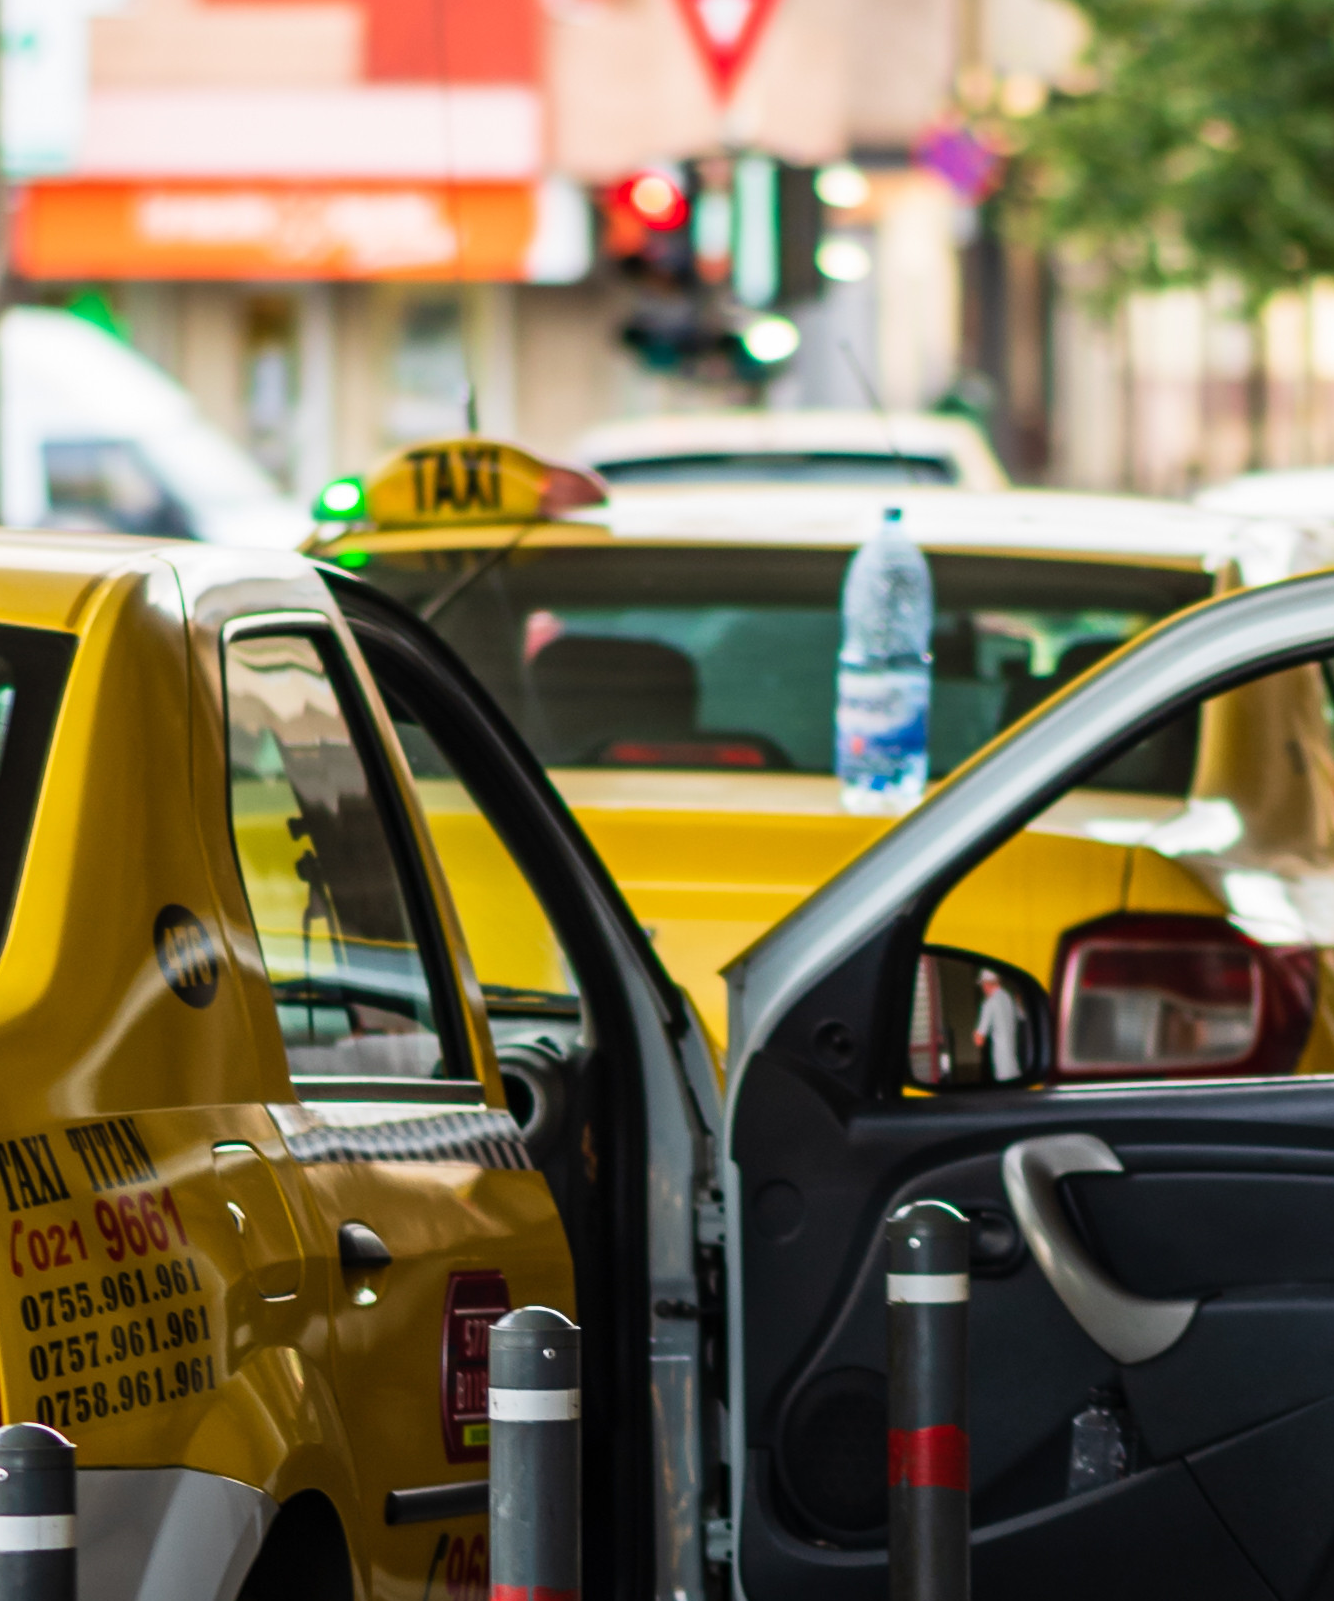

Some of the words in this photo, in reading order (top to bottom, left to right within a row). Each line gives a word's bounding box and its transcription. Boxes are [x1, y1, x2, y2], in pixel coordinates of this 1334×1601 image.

[405, 445, 503, 511] TAXI
[65, 1117, 158, 1192] TITAN
[27, 1220, 88, 1271] 021
[95, 1187, 188, 1263] 9661
[20, 1257, 202, 1333] 0755.961.961
[29, 1305, 211, 1382] 0757.961.961
[37, 1355, 216, 1428] 0758.961.961
